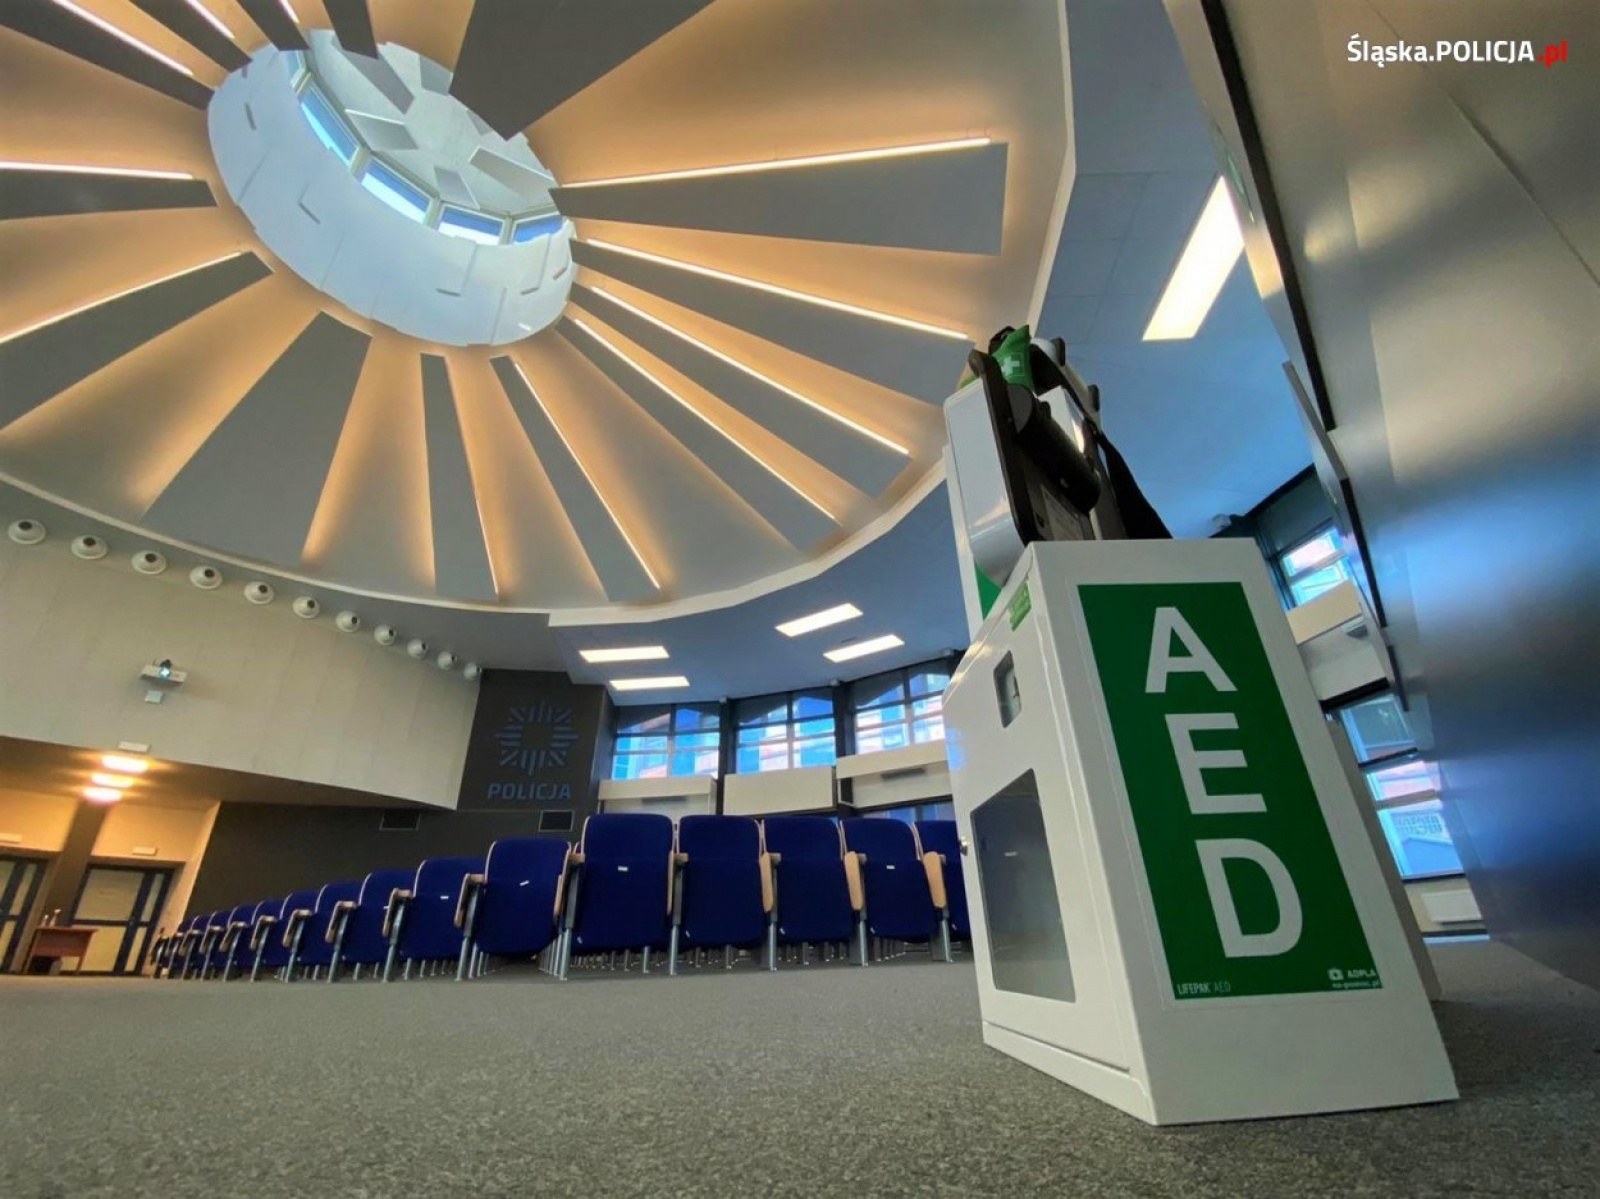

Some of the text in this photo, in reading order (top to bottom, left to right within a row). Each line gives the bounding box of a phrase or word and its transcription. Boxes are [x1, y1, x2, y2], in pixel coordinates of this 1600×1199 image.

[487, 782, 572, 800] POLICJA
[1145, 606, 1303, 958] AED
[1176, 980, 1232, 995] LIFEPAK AED
